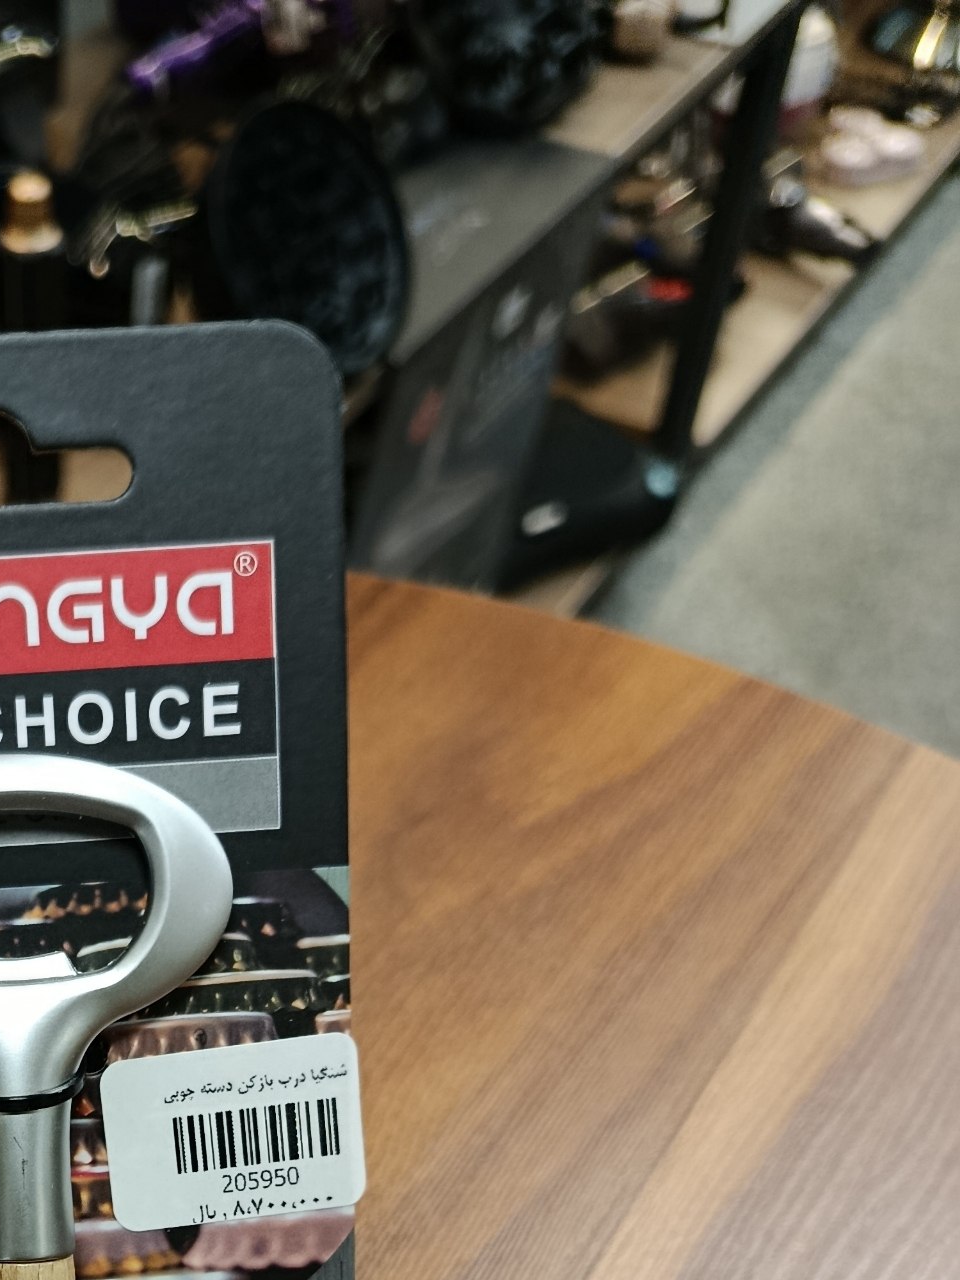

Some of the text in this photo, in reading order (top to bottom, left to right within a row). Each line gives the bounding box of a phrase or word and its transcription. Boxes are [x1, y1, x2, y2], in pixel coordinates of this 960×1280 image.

[200, 1081, 233, 1095] دسته
[278, 1072, 306, 1089] درب
[221, 1166, 300, 1194] 205950
